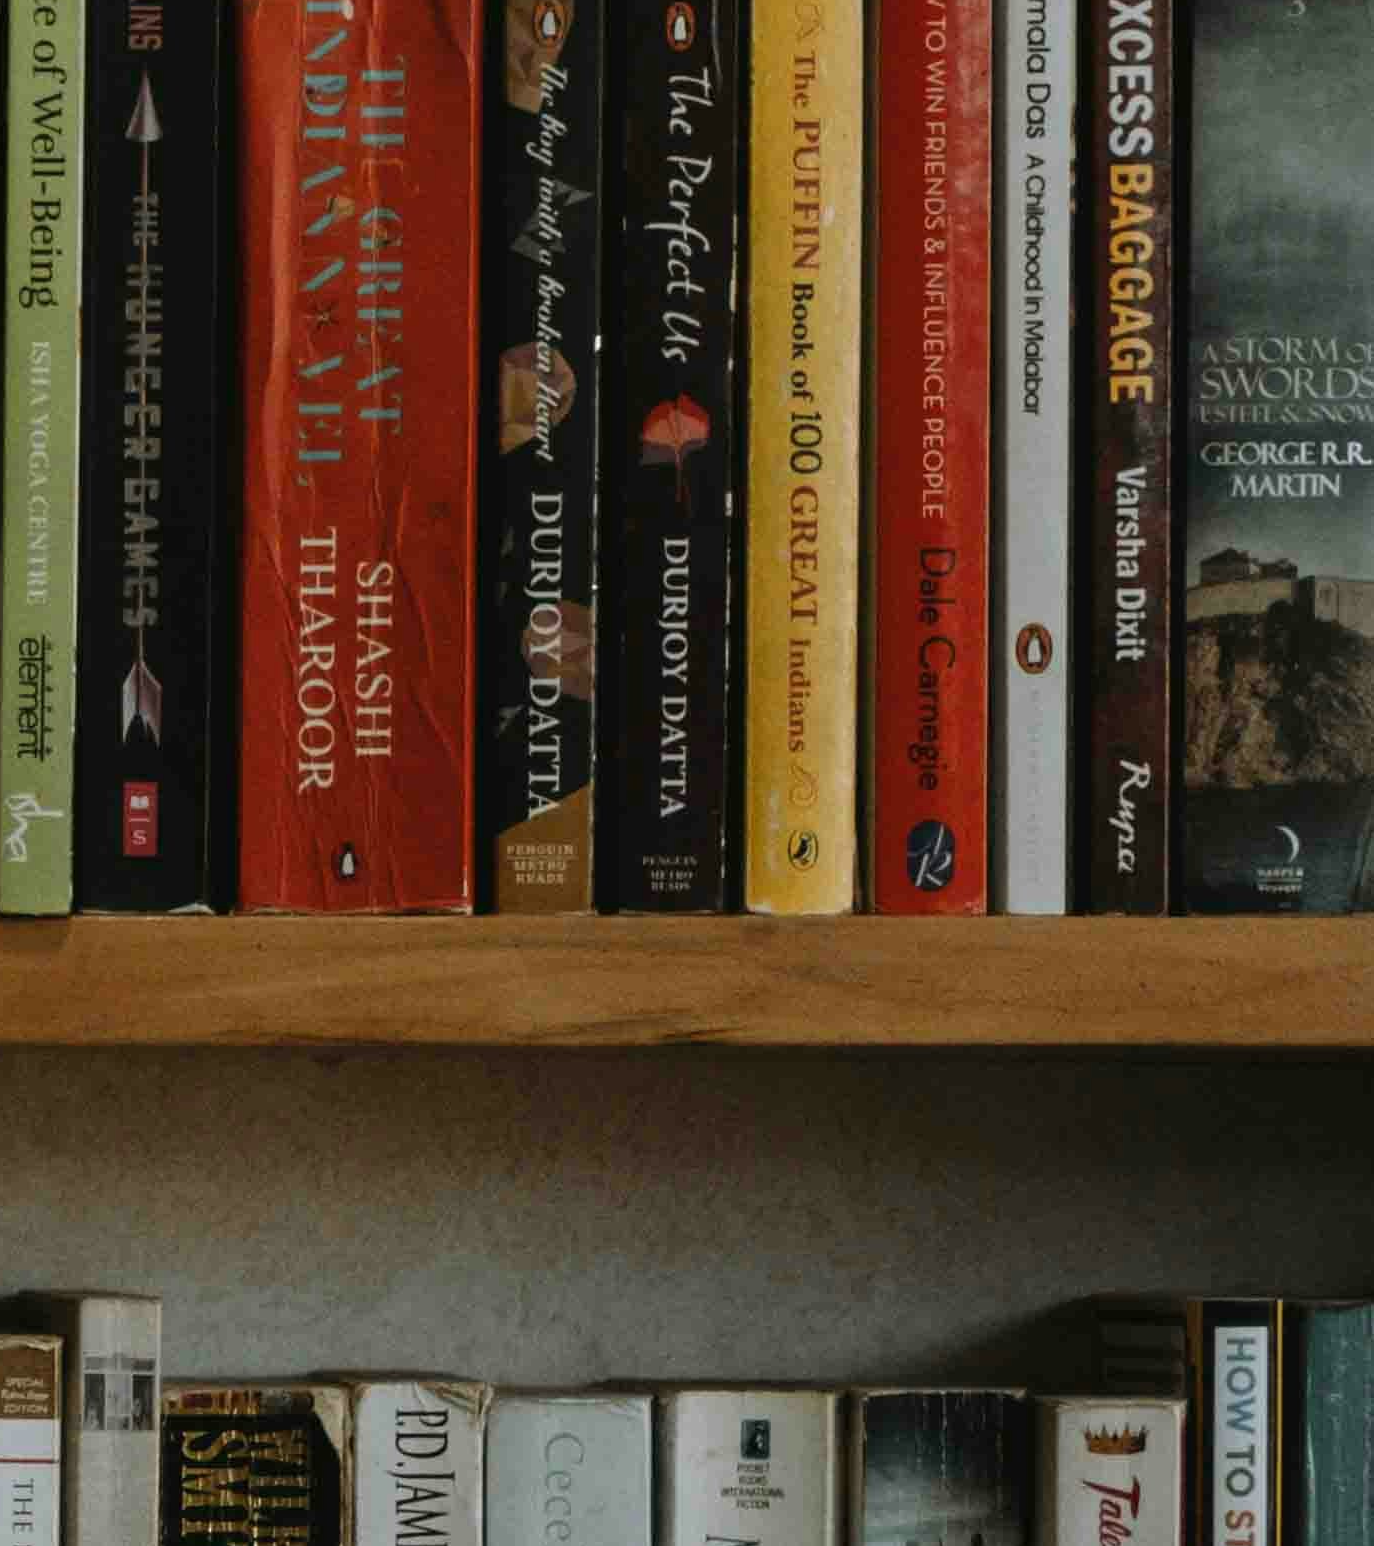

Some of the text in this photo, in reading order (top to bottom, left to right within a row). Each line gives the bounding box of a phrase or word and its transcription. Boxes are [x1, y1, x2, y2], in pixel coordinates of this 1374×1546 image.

[32, 39, 64, 81] of
[1024, 82, 1052, 139] Das
[18, 90, 62, 309] Well-Being
[1024, 155, 1044, 169] A
[132, 195, 160, 247] THE
[1021, 175, 1046, 289] Childhood
[1023, 294, 1044, 315] in
[1107, 163, 1153, 404] BAGGAGE
[121, 262, 163, 459] HUNGER
[1022, 320, 1046, 416] Malabar
[644, 67, 710, 817] The Perfect Us DURJOY DATTA
[1231, 472, 1342, 500] MARTIN
[123, 477, 160, 628] GAMES
[1112, 465, 1148, 580] Varsha
[295, 526, 338, 794] THAROOR
[353, 558, 395, 759] SHASHI
[1112, 587, 1147, 661] Dixit
[1224, 1336, 1256, 1433] HOW
[1224, 1445, 1254, 1499] TO
